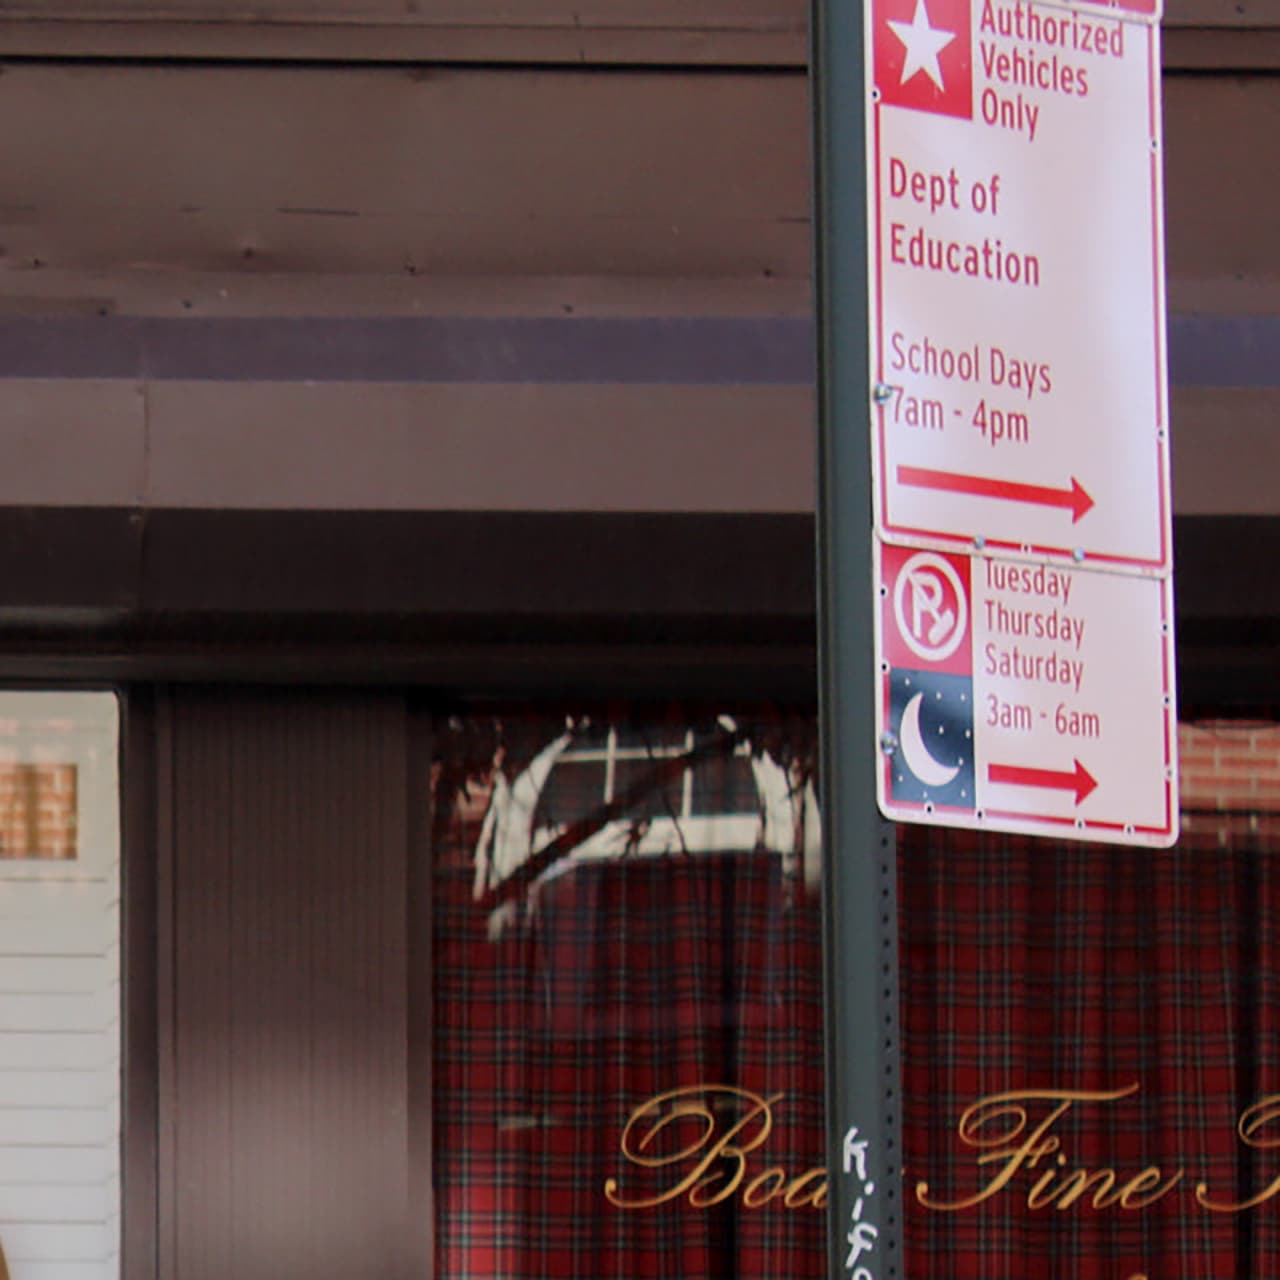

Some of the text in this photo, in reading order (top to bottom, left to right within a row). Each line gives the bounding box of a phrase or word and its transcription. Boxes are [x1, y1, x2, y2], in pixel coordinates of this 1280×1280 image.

[980, 0, 1124, 58] Authorized
[980, 42, 1088, 96] Vehicles
[981, 90, 1039, 141] Only
[890, 158, 1000, 215] Dept of
[891, 224, 1039, 286] Education
[892, 332, 1052, 399] School Days
[890, 387, 943, 430] 7am
[972, 400, 1029, 446] 4pm
[984, 557, 1072, 607] Tuesday
[985, 600, 1085, 649] Thursday
[985, 645, 1084, 691] Saturday
[986, 694, 1032, 731] 3am
[1055, 702, 1101, 739] 6am
[916, 1082, 1185, 1210] Fine
